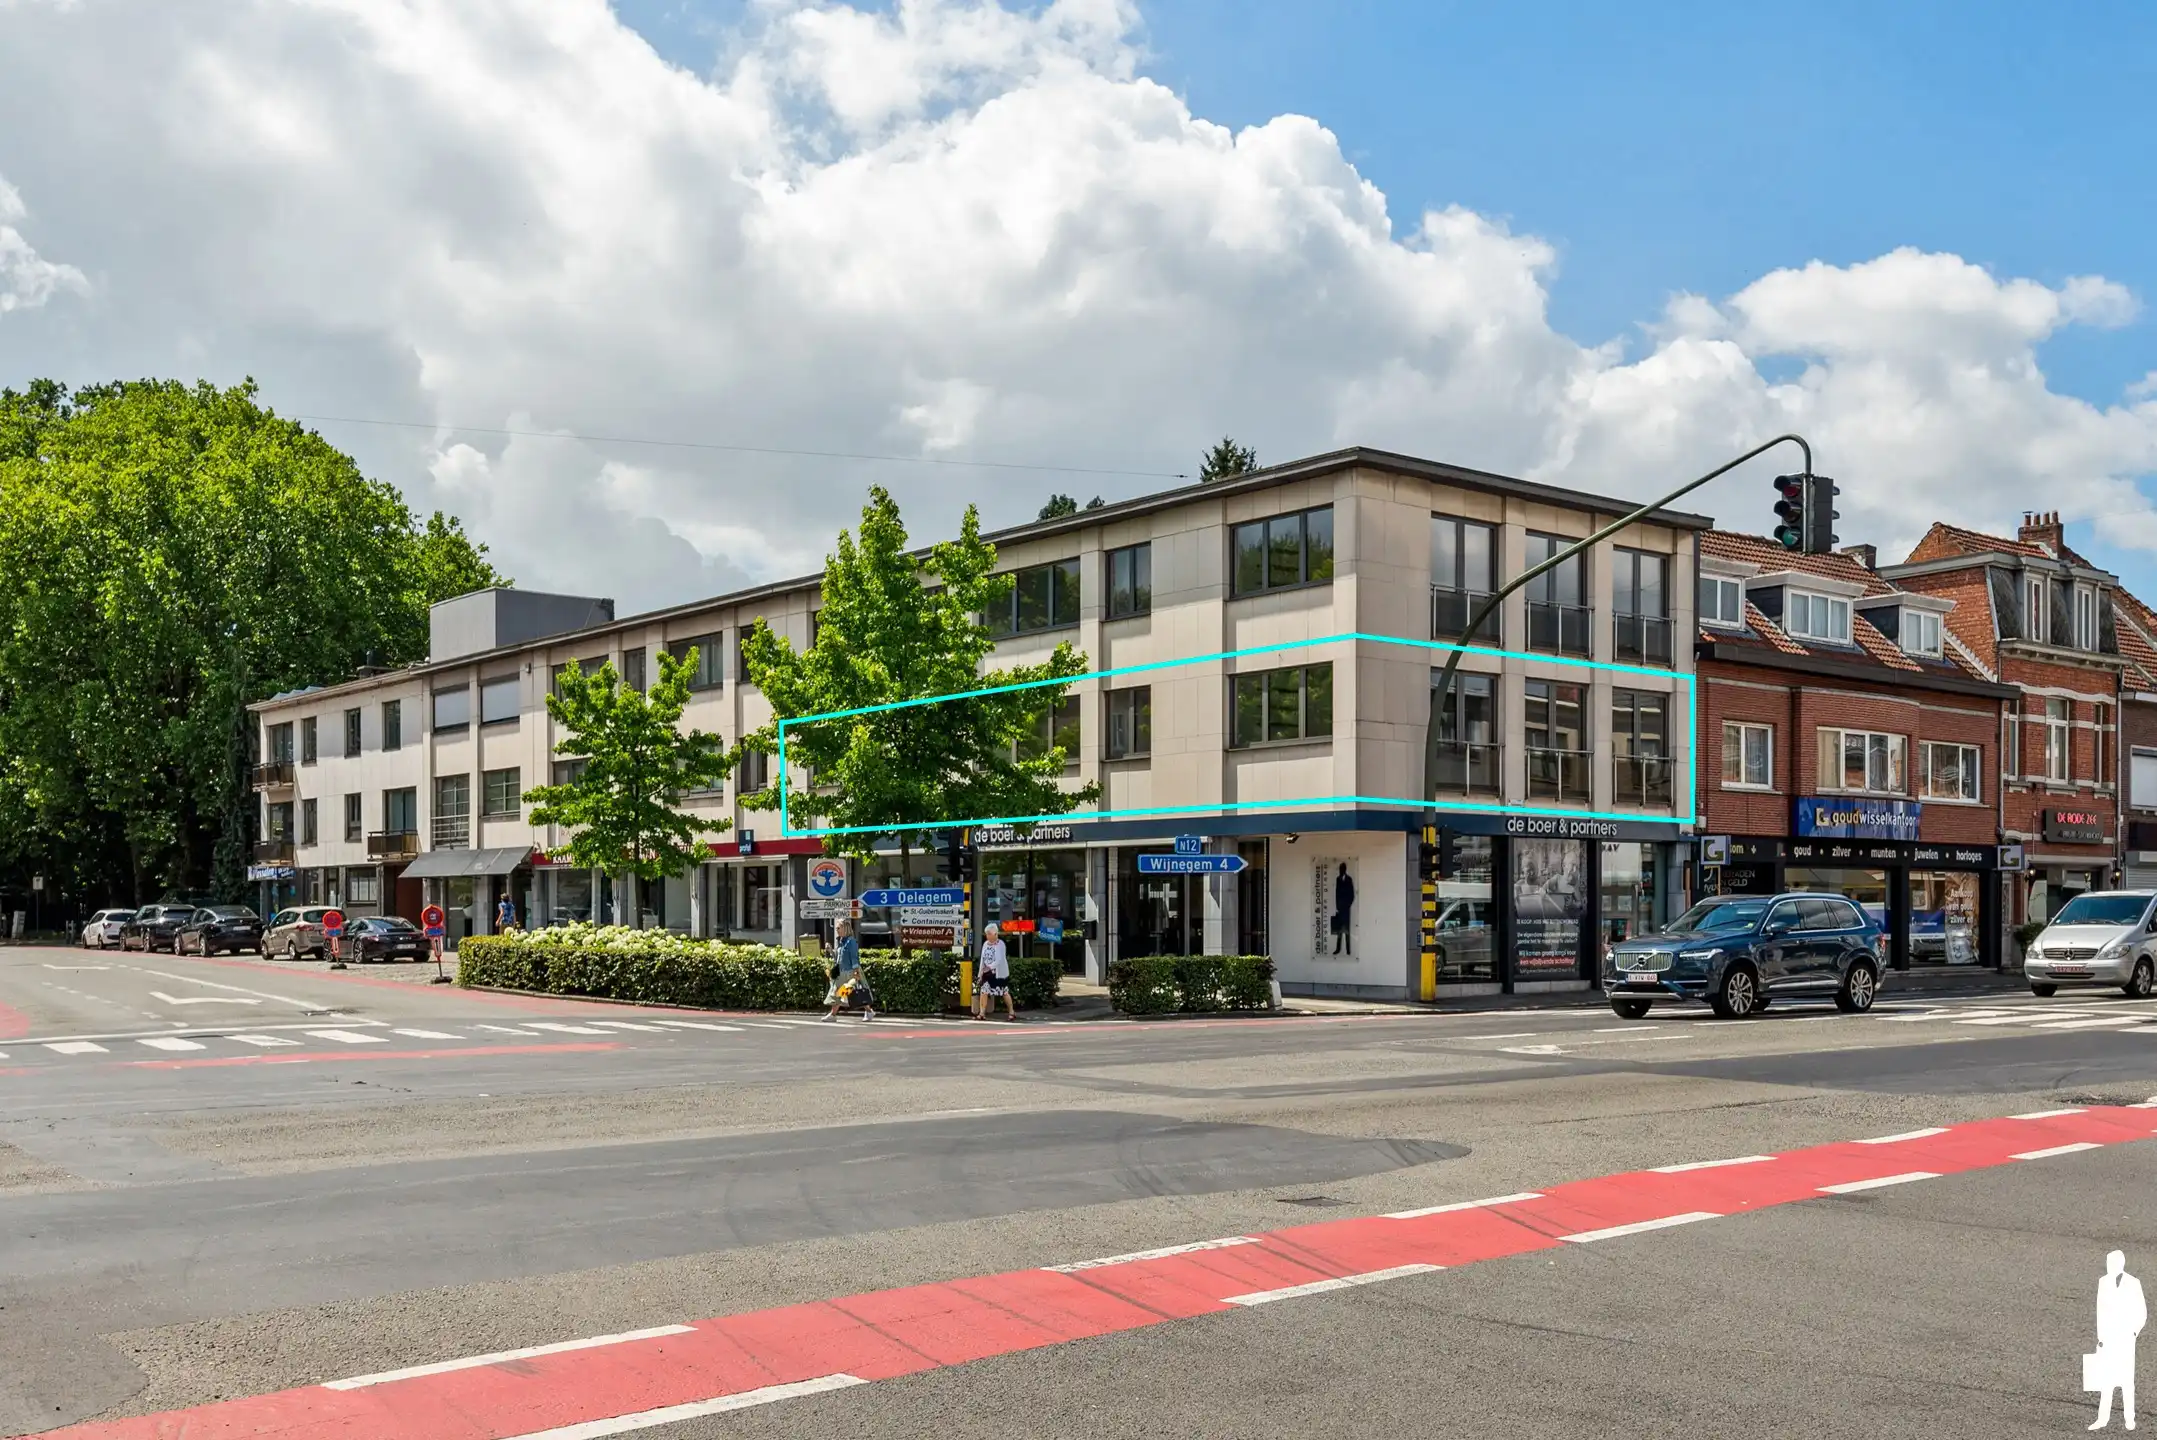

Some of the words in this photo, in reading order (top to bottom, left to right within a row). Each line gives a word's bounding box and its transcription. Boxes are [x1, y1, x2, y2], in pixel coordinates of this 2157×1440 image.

[1832, 809, 1917, 827] goudwisselkantoor
[1507, 817, 1524, 832] de
[1527, 818, 1556, 833] boer
[1558, 818, 1567, 833] &
[1570, 820, 1617, 837] partners
[974, 829, 988, 842] de
[990, 828, 1014, 842] boer
[1180, 840, 1197, 851] N12
[1794, 846, 1812, 858] goud
[1832, 846, 1851, 858] zilver
[1870, 848, 1897, 858] munten
[1914, 848, 1939, 861] juwelen
[1956, 850, 1982, 863] horloges
[1150, 858, 1212, 873] Wijnegem
[1220, 858, 1228, 870] 4
[880, 892, 888, 904] 3
[898, 892, 952, 905] Oelegem
[911, 918, 962, 928] Containerpark
